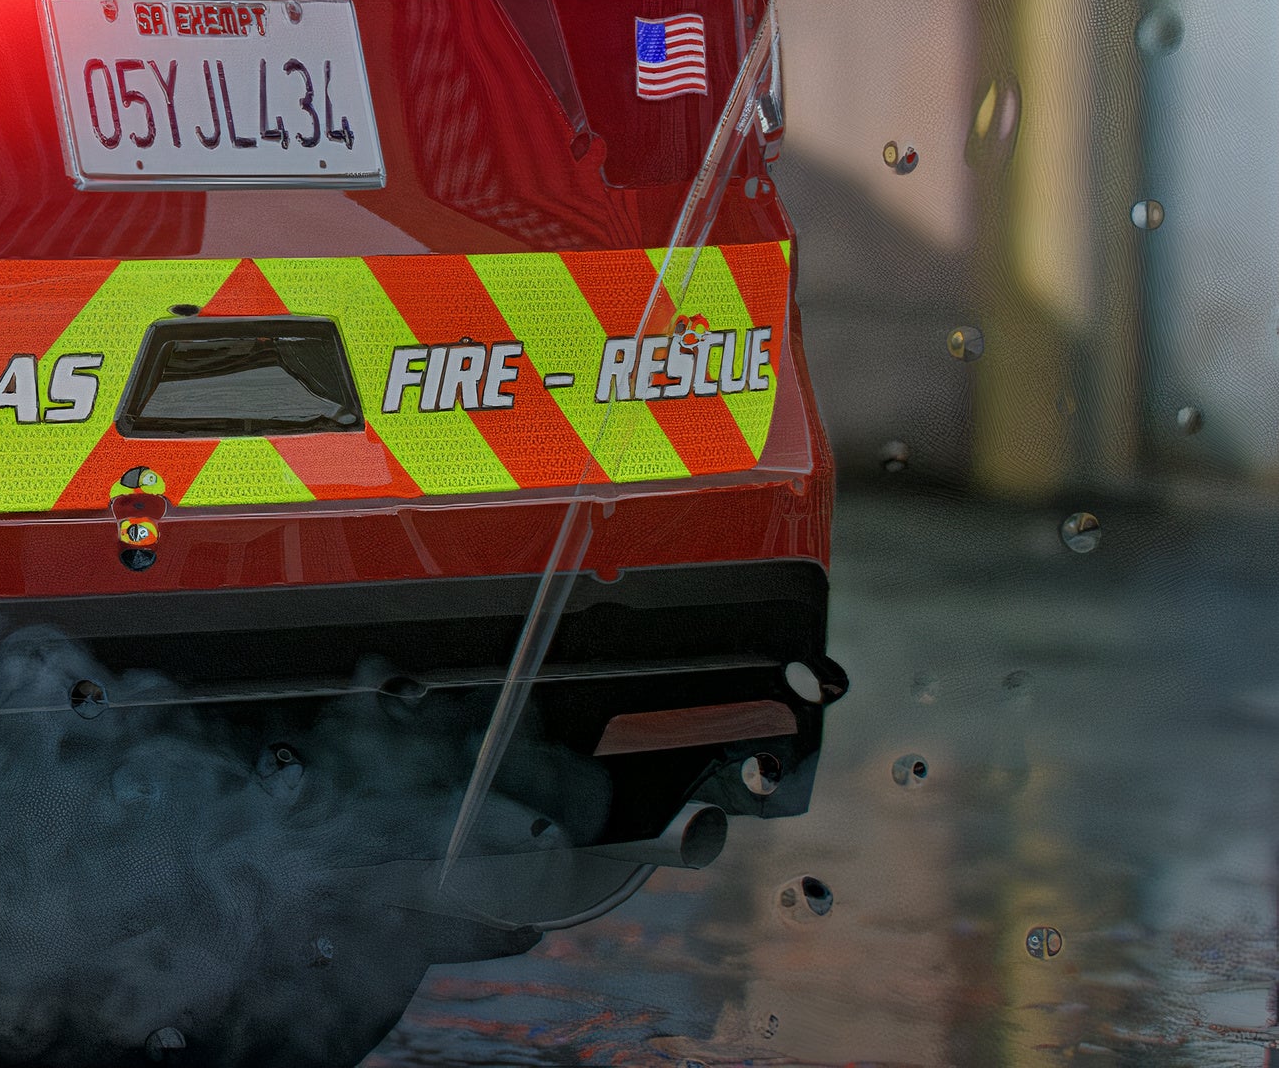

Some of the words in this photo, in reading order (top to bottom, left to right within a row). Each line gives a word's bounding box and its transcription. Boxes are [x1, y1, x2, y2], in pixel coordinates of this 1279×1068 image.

[134, 2, 169, 36] SA
[174, 2, 268, 37] EXEMPT
[381, 340, 524, 413] FIRE
[594, 326, 773, 404] RESCUE
